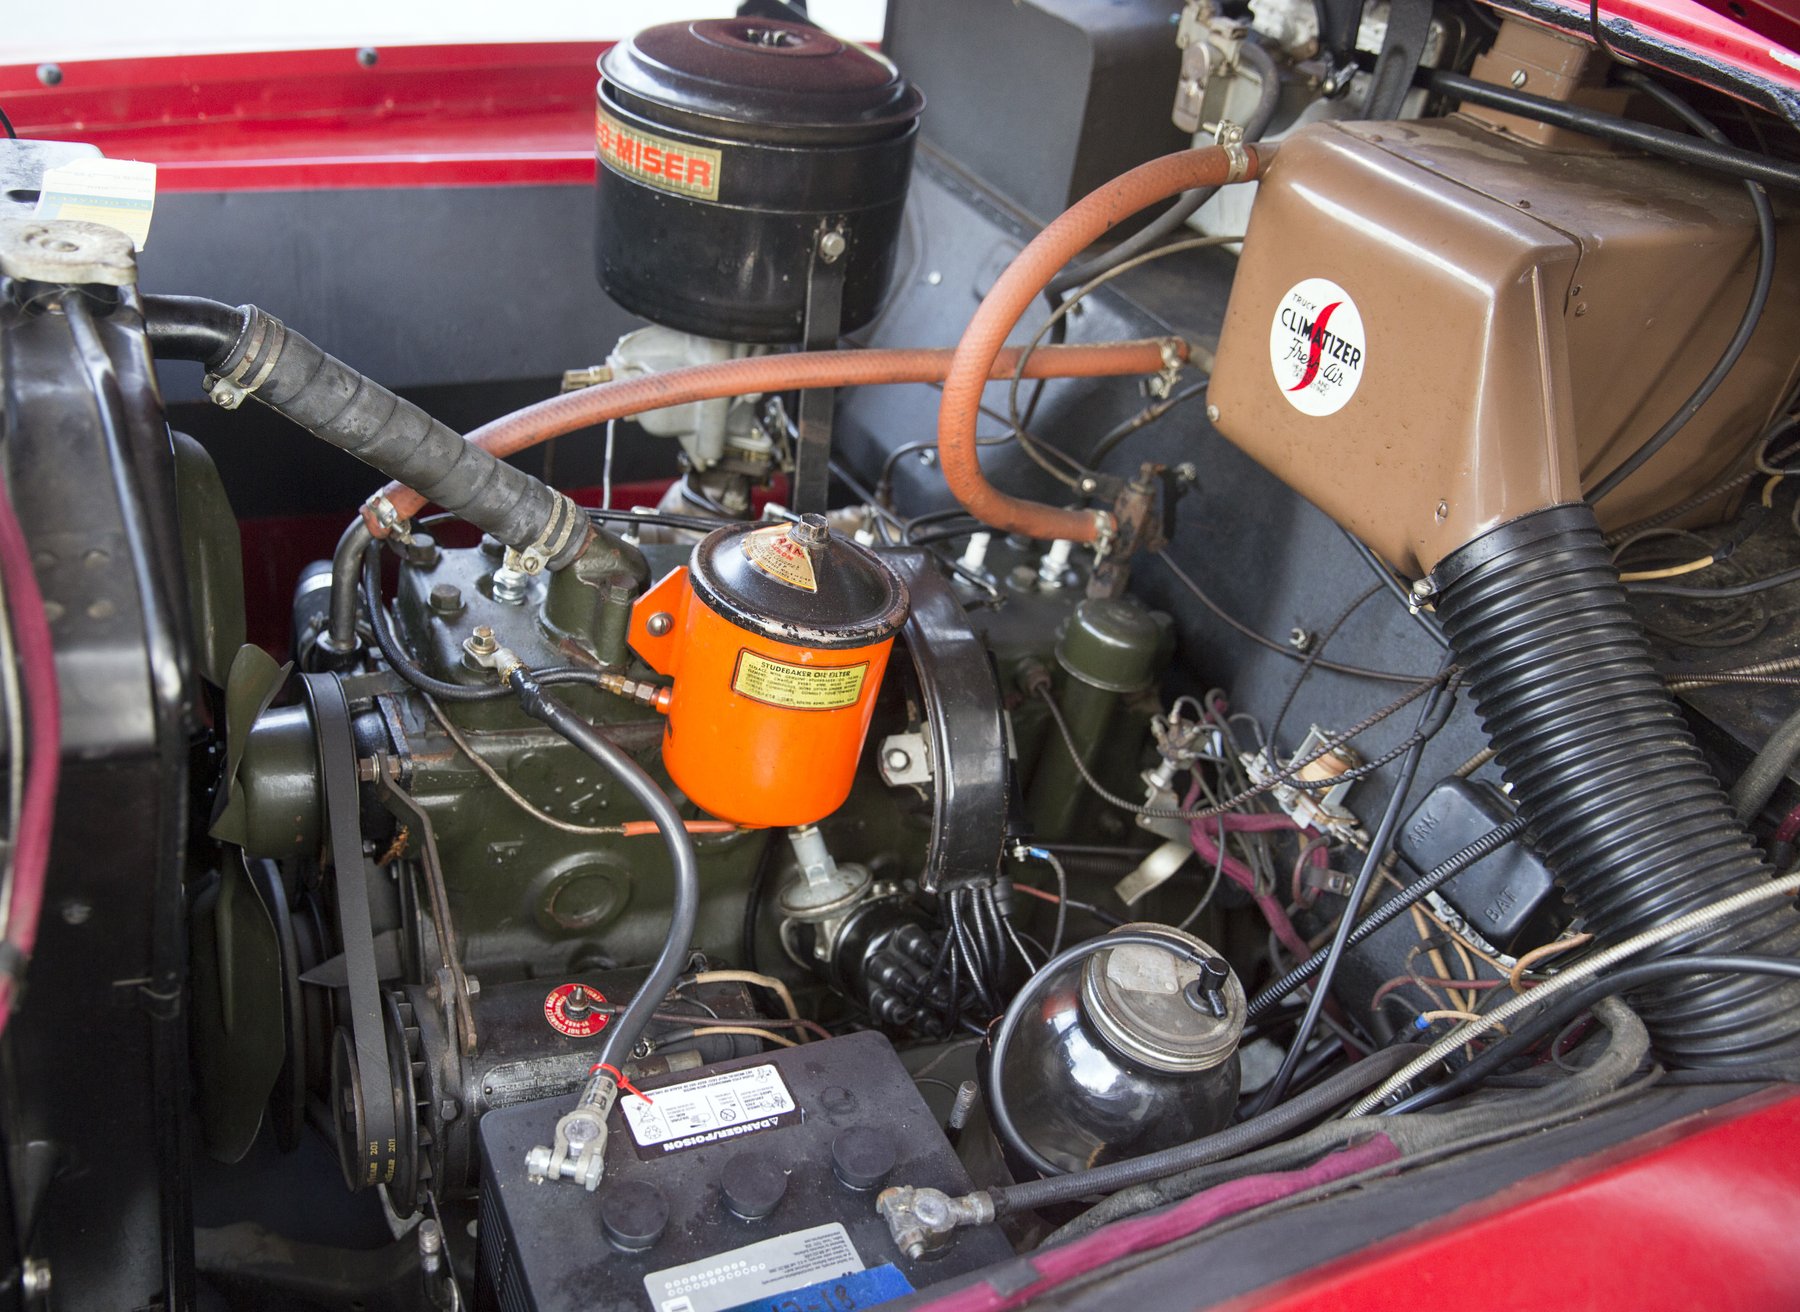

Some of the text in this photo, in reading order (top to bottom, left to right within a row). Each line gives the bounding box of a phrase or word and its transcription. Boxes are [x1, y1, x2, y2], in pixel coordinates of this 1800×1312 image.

[1292, 293, 1317, 312] TRUCK
[1281, 308, 1361, 371] CLIMATIZER
[761, 661, 812, 678] STUDEBAKER
[828, 670, 851, 678] FILTER
[1407, 811, 1440, 849] ARM
[1484, 885, 1518, 924] BAT
[369, 1141, 378, 1156] 201
[387, 1138, 396, 1153] 201
